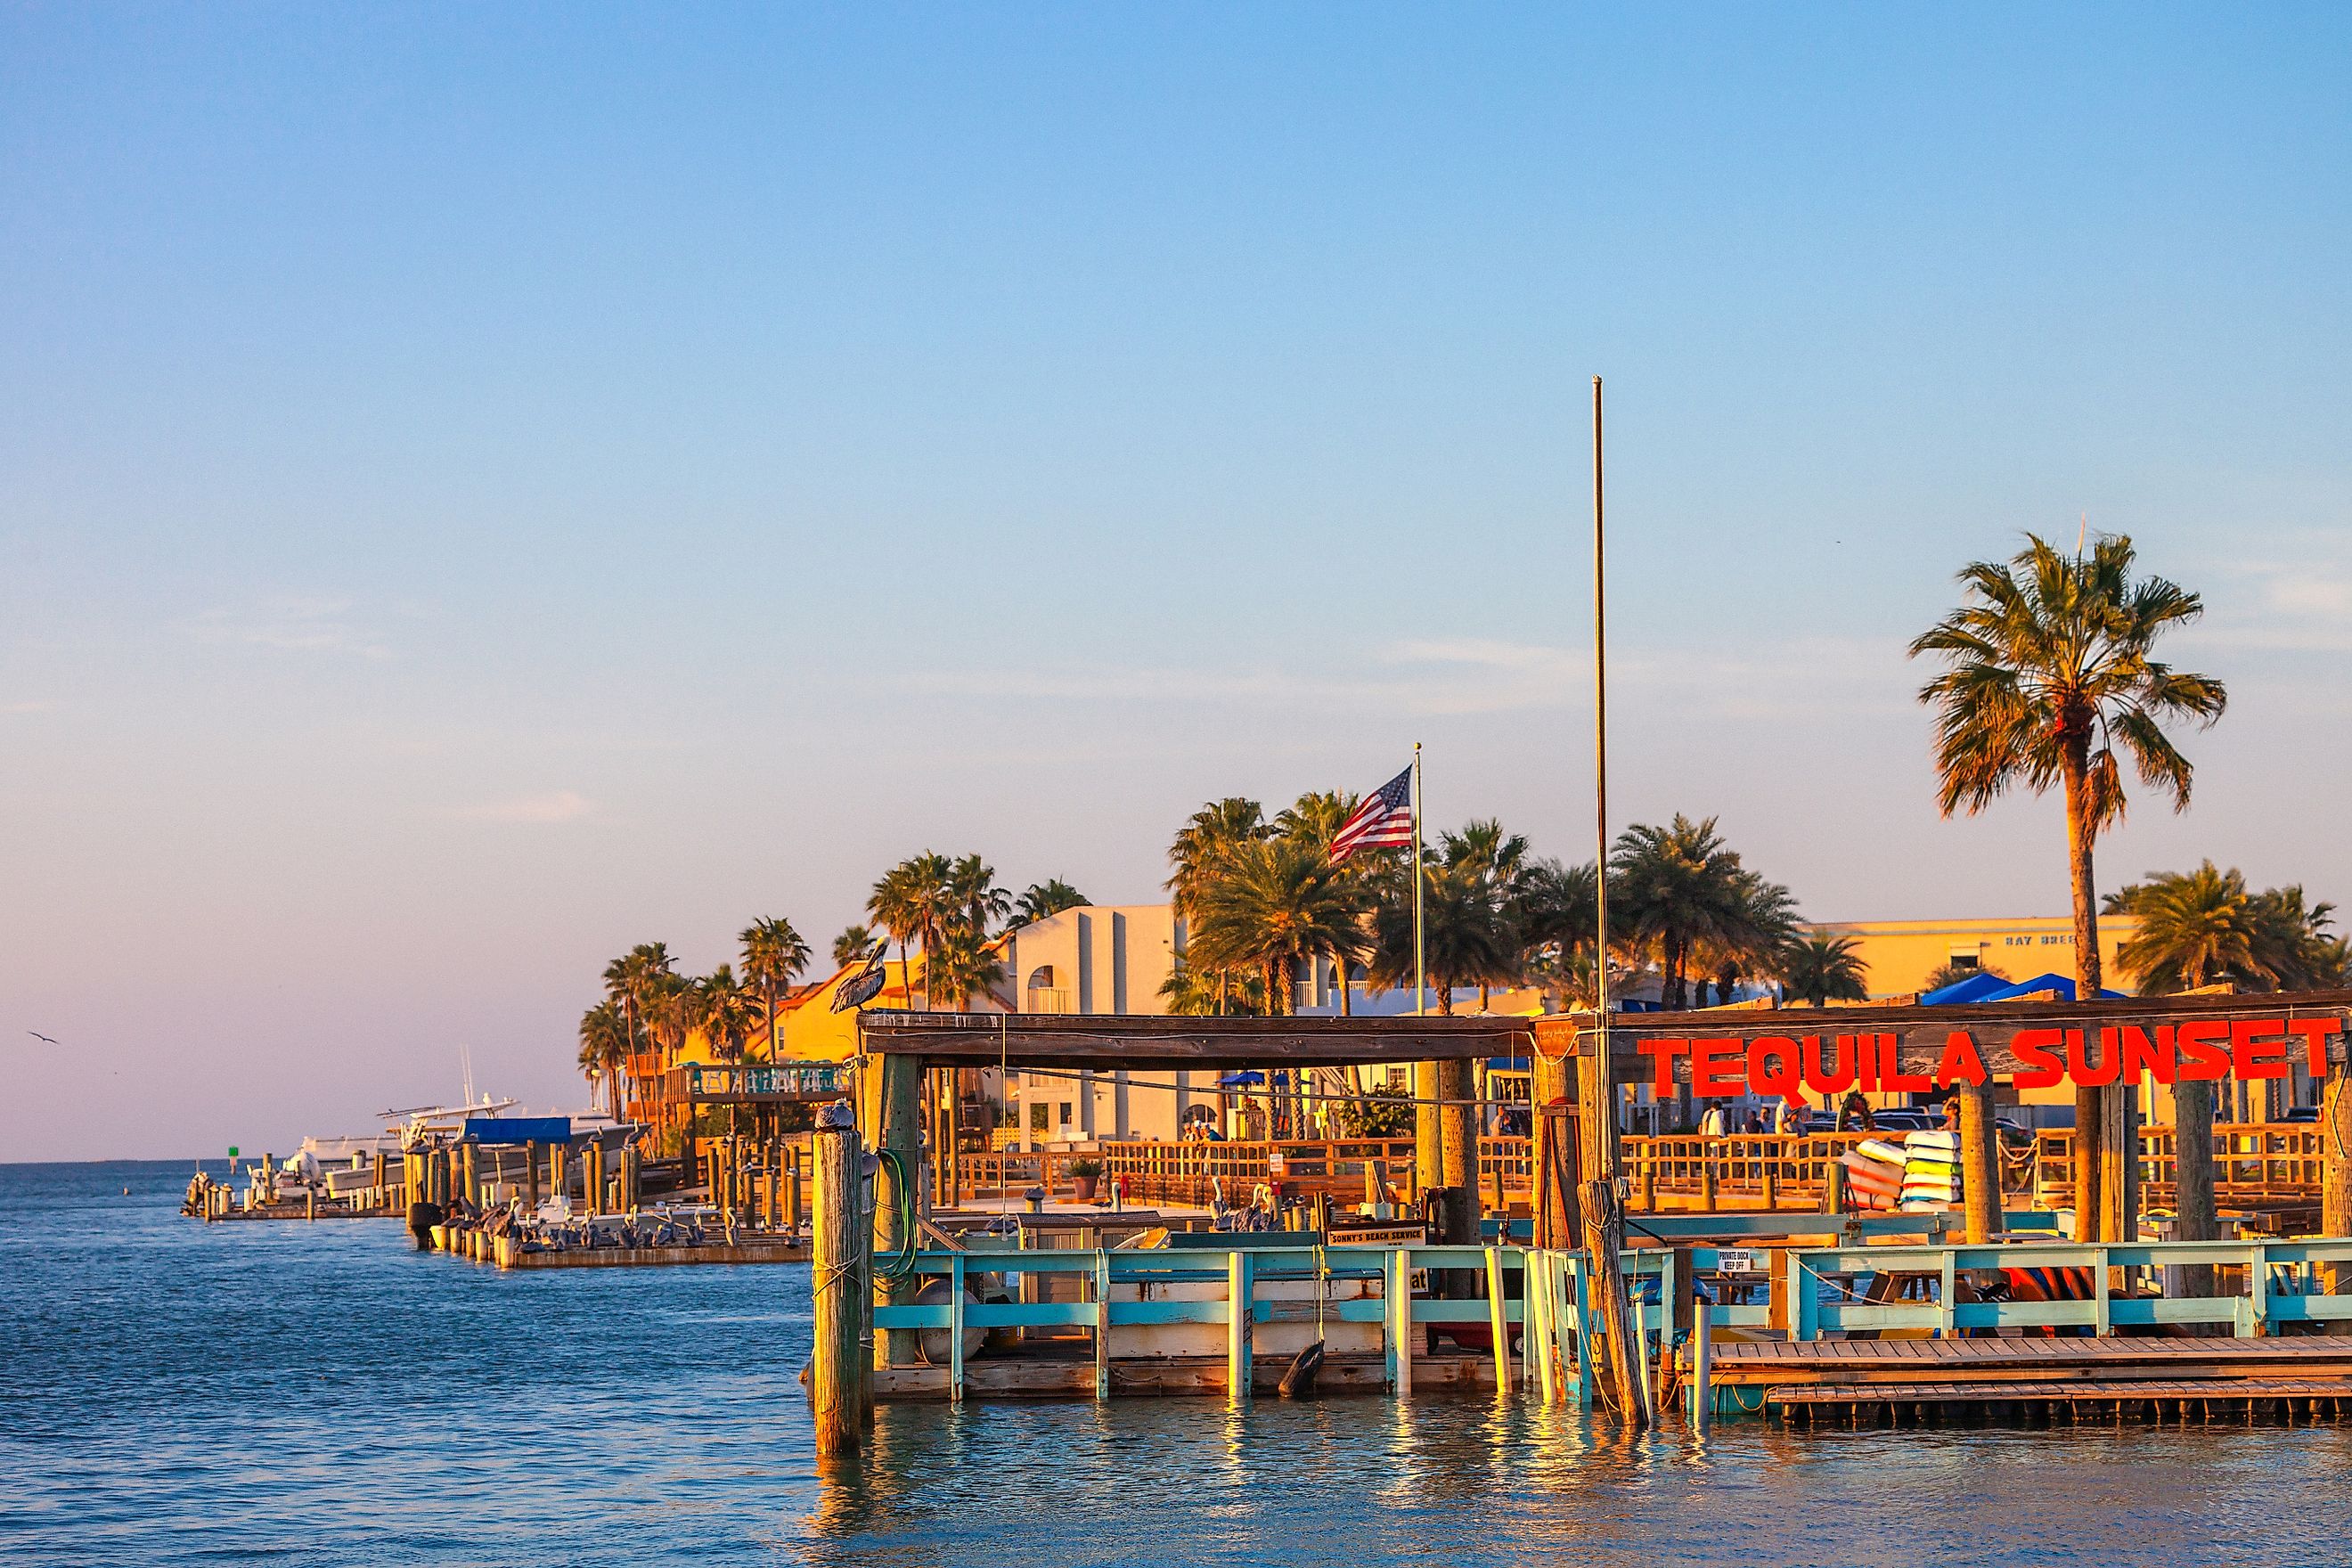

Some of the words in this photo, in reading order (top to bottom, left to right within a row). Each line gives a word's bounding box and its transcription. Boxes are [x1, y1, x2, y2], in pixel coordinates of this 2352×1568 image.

[2005, 936, 2032, 945] BAY
[2040, 935, 2076, 944] BREE
[1637, 1032, 1988, 1110] TEQUILA
[2010, 1018, 2342, 1090] SUNSET
[1332, 1233, 1363, 1244] SONNY'S
[1365, 1231, 1389, 1241] BEACH
[1391, 1229, 1421, 1240] SERVICE
[1719, 1251, 1736, 1261] PRIVATE
[1737, 1251, 1749, 1261] DOCK
[1724, 1261, 1735, 1270] KEEP
[1735, 1261, 1744, 1270] OFF
[1410, 1268, 1426, 1289] at
